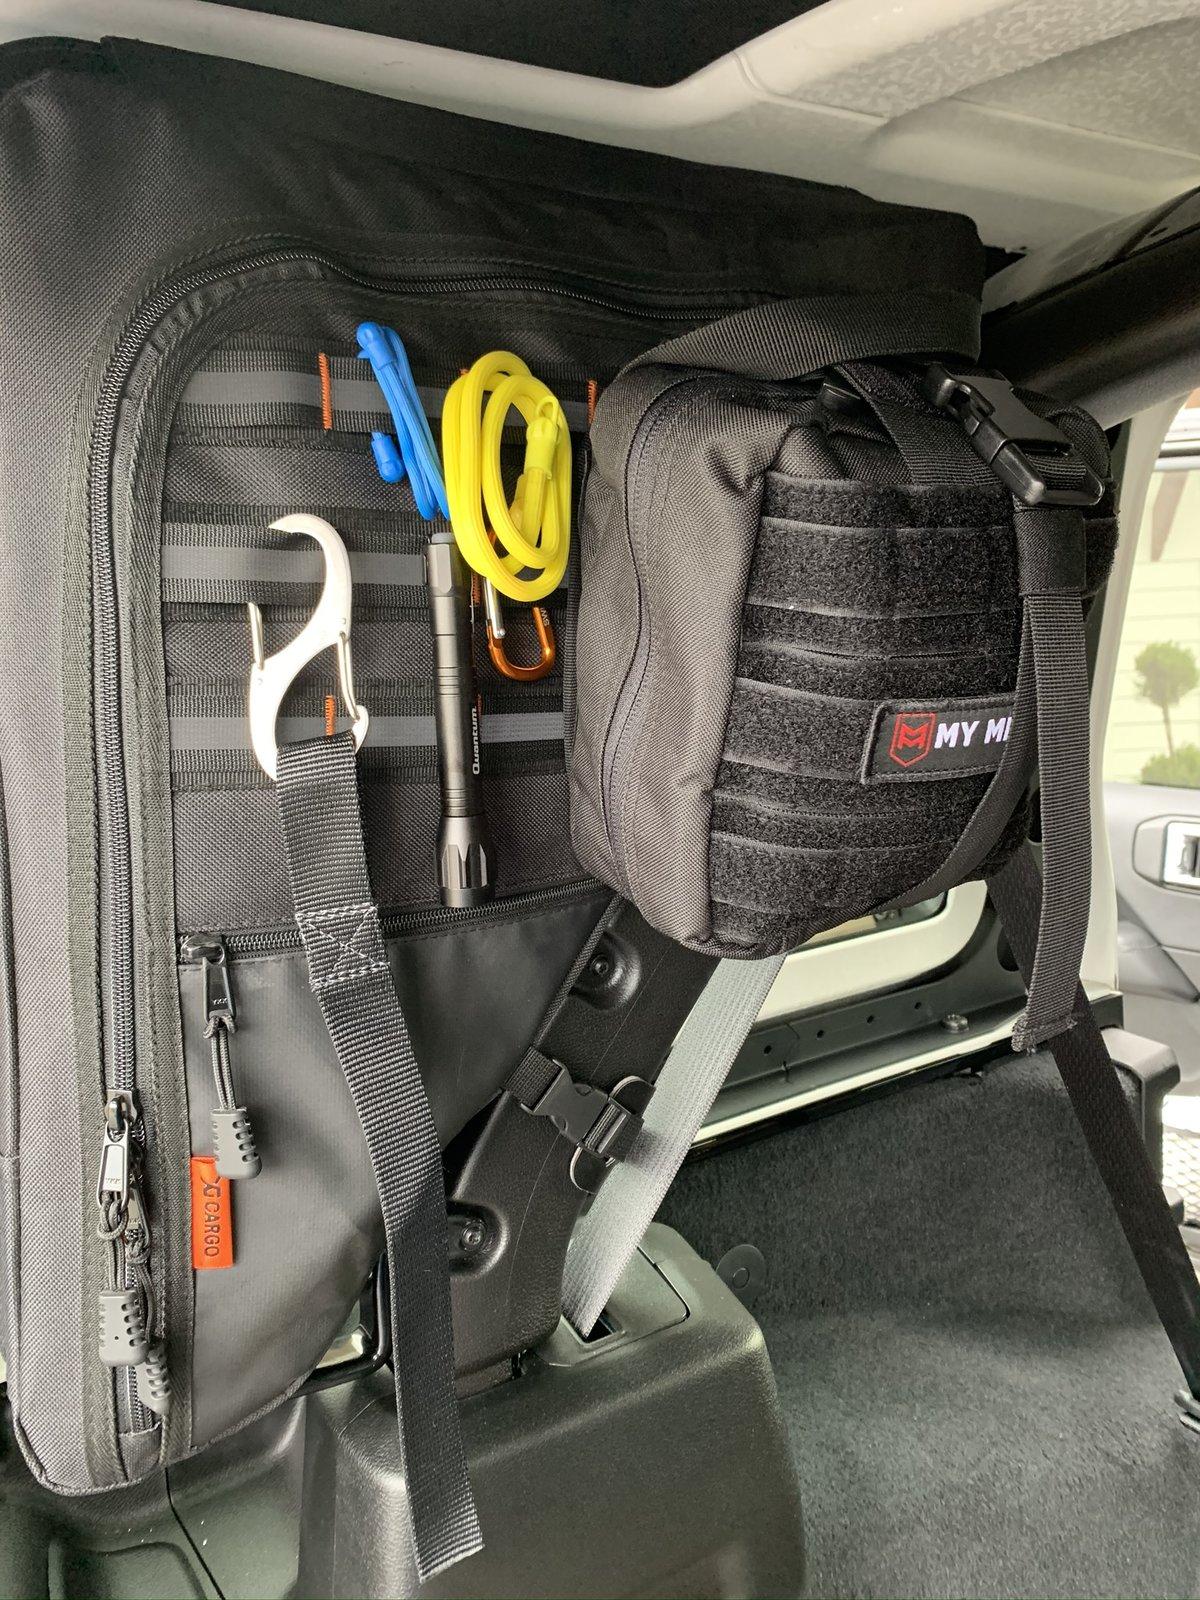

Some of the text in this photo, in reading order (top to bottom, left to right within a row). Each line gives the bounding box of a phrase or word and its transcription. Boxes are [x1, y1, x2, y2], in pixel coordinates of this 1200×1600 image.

[471, 706, 480, 775] Quantum
[934, 720, 980, 749] MY
[204, 1201, 221, 1257] CARGO
